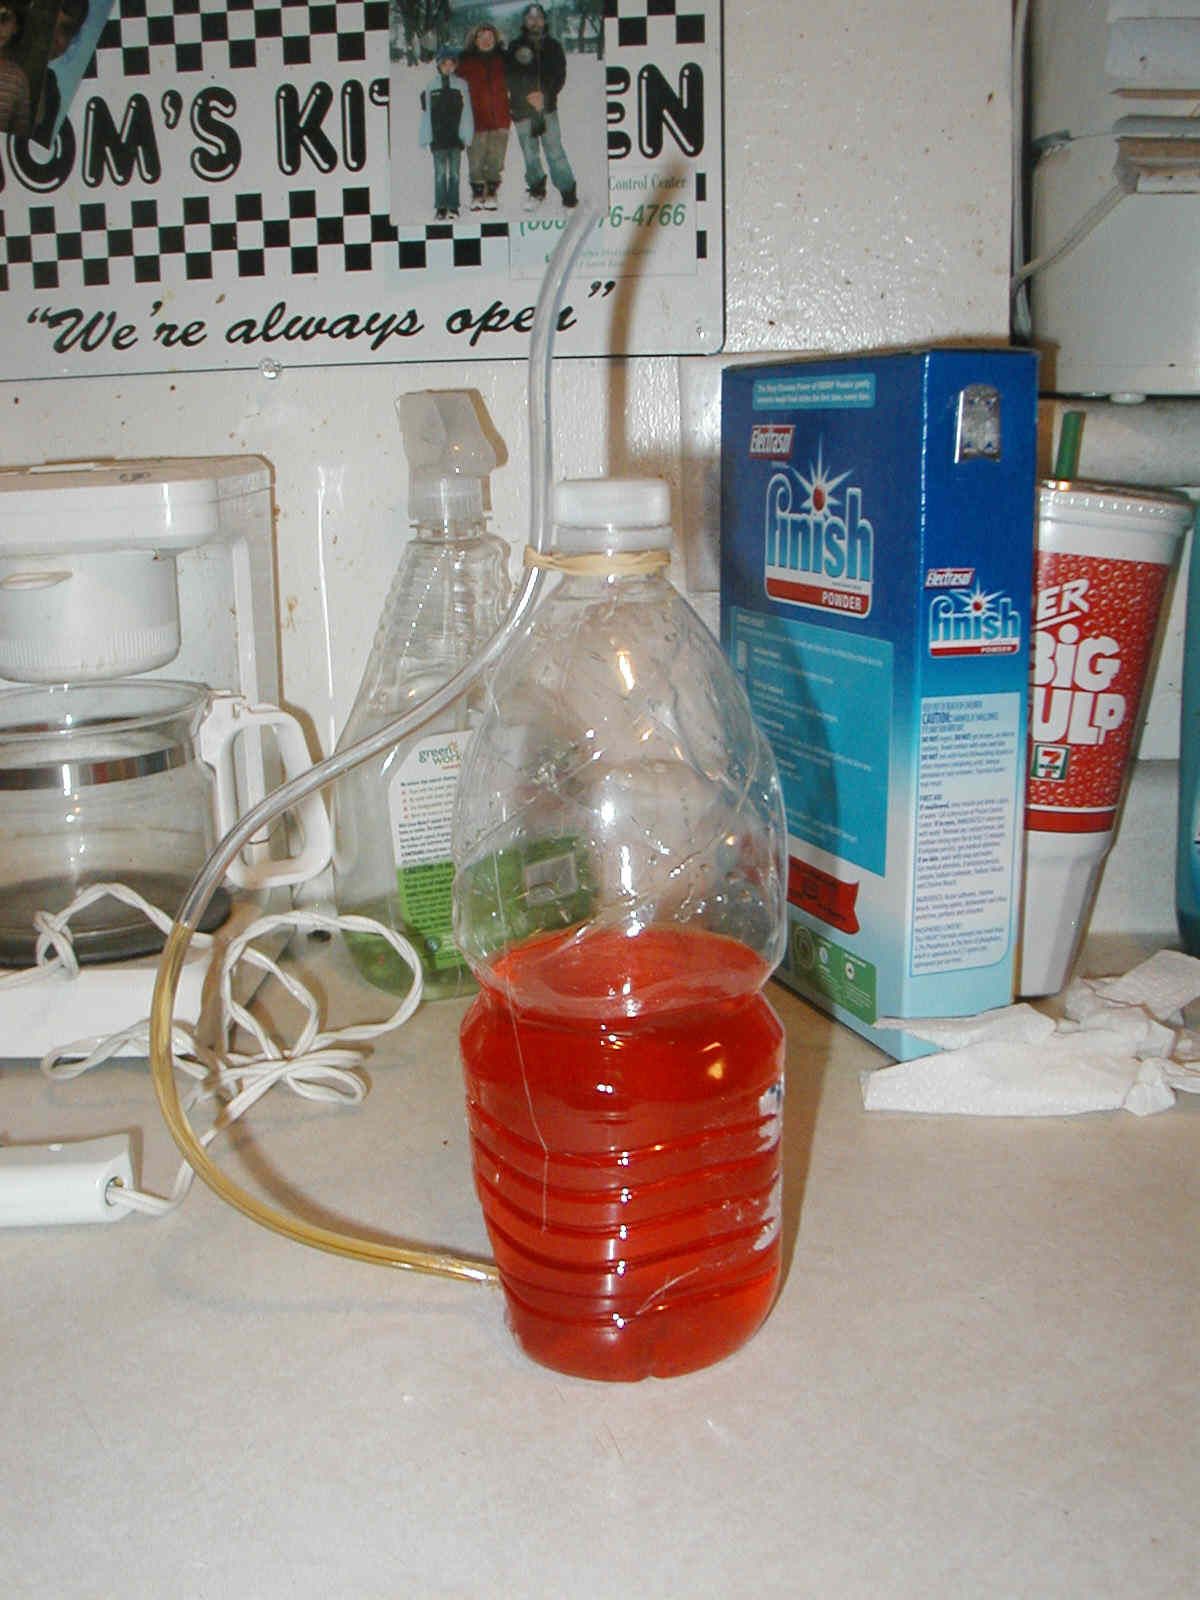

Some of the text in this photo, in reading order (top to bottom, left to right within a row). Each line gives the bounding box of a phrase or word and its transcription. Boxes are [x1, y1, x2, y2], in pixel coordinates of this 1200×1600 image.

[0, 85, 242, 194] OM'S
[608, 172, 688, 191] Control Center
[597, 202, 687, 228] 6-4766
[224, 301, 425, 351] always
[765, 472, 874, 583] finish
[821, 591, 862, 611] POWDER
[929, 595, 1020, 642] finish
